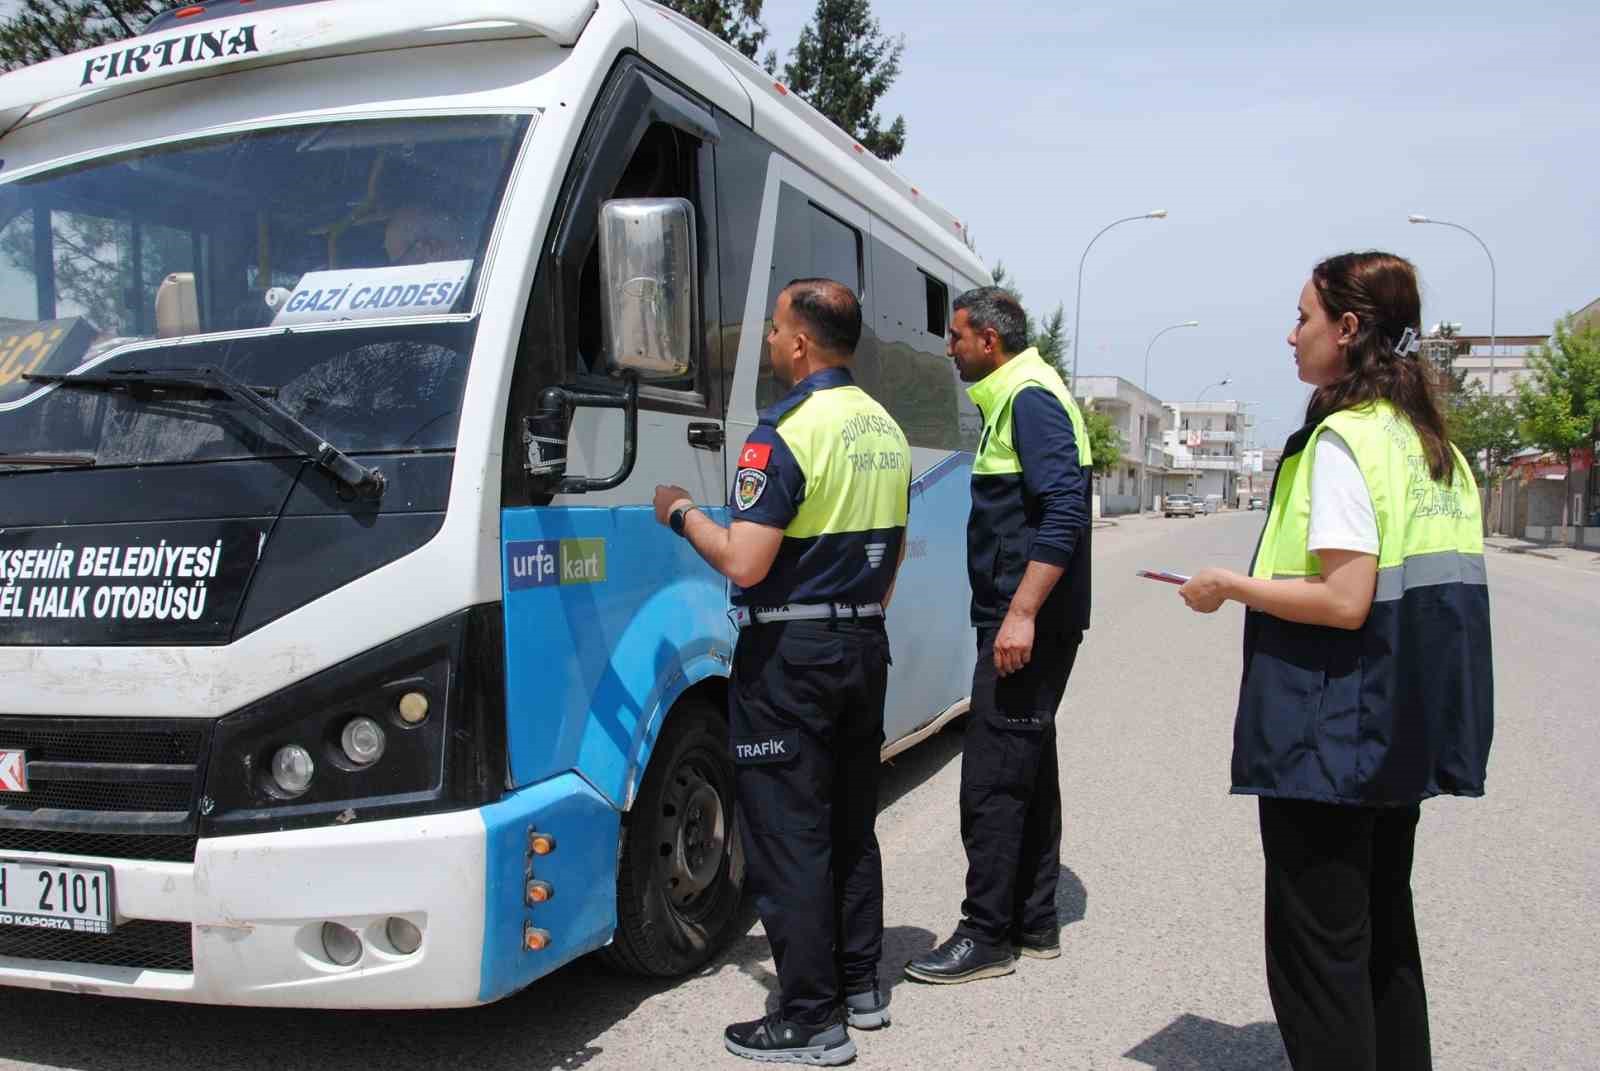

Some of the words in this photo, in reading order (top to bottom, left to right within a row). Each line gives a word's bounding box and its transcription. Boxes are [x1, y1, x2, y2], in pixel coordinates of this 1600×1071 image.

[80, 25, 258, 87] FIRTINA
[286, 283, 352, 313] GAZİ
[350, 276, 465, 309] CADDESİ
[77, 539, 222, 578] BELEDİYESİ
[513, 544, 554, 582] urfa
[562, 545, 600, 580] kart
[0, 586, 24, 618] EL
[28, 586, 90, 618] HALK
[93, 580, 207, 620] OTOBÜSÜ
[38, 870, 101, 916] 2101
[15, 915, 72, 930] KAPORTA
